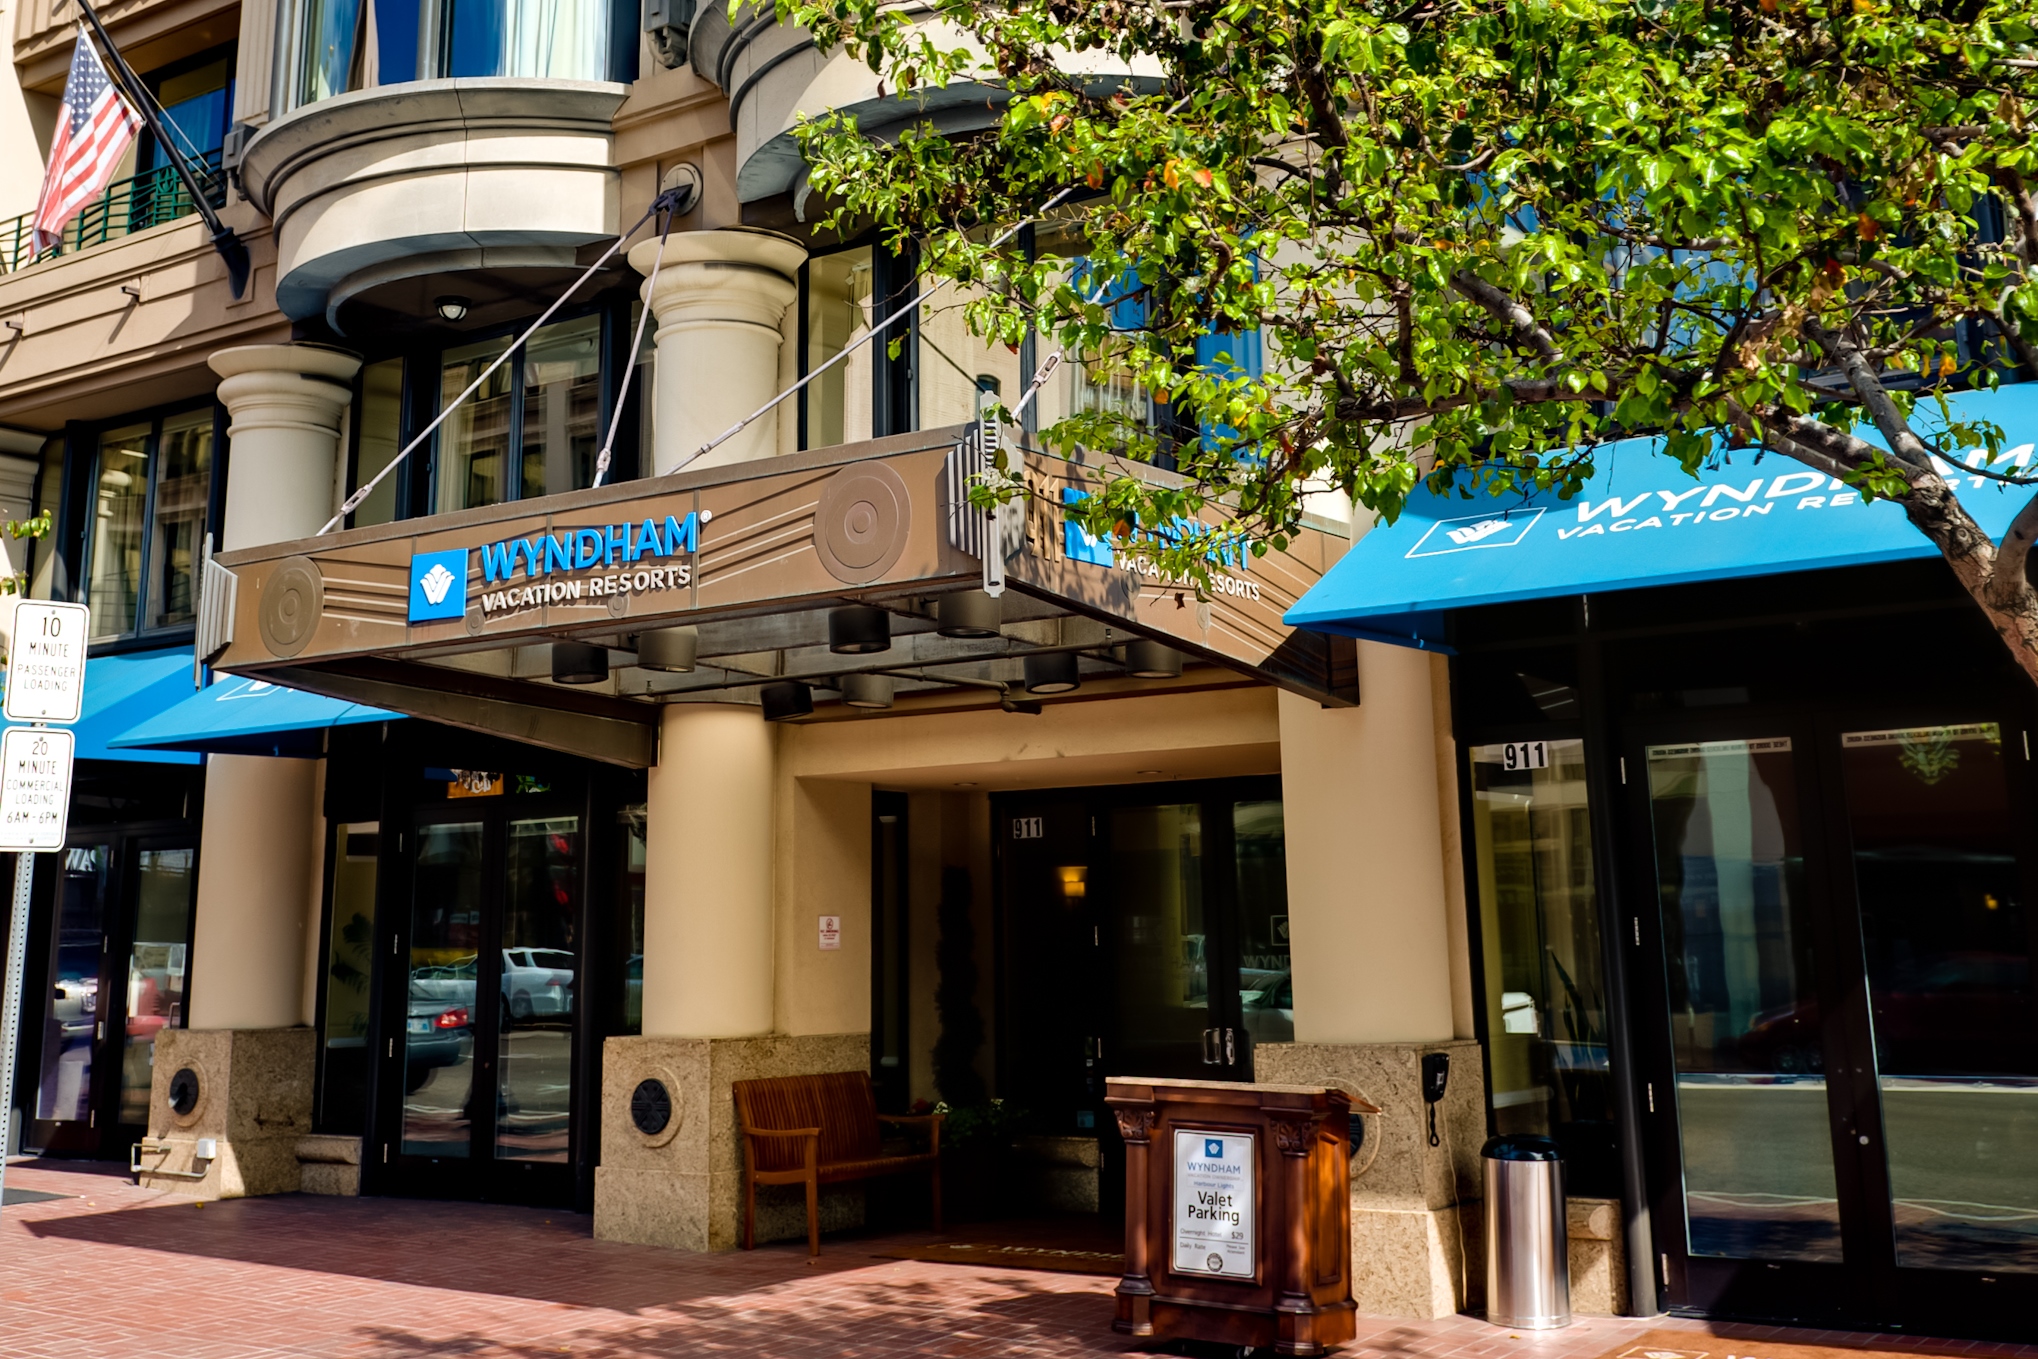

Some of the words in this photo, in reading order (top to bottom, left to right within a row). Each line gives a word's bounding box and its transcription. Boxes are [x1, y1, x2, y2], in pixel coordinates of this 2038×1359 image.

[1556, 502, 1773, 540] VACATION
[481, 512, 698, 582] WYNDHAM
[482, 581, 580, 612] VACATION
[590, 565, 691, 596] RESORTS
[1198, 572, 1260, 601] ESORTS
[42, 617, 61, 637] 10
[29, 642, 68, 658] MINUTE
[17, 664, 76, 678] PASSENGER
[24, 678, 68, 692] LOADING
[32, 741, 48, 755] 20
[1505, 743, 1544, 769] 911
[19, 761, 56, 776] MINUTE
[6, 780, 63, 792] COMMERCIAL
[15, 794, 54, 805] LOADING
[1015, 818, 1040, 837] 911
[1187, 1162, 1240, 1174] WYNDHAM
[1198, 1191, 1232, 1207] Valet
[1188, 1205, 1240, 1226] Parking
[1180, 1228, 1205, 1236] Overnight
[1232, 1231, 1244, 1240] $29
